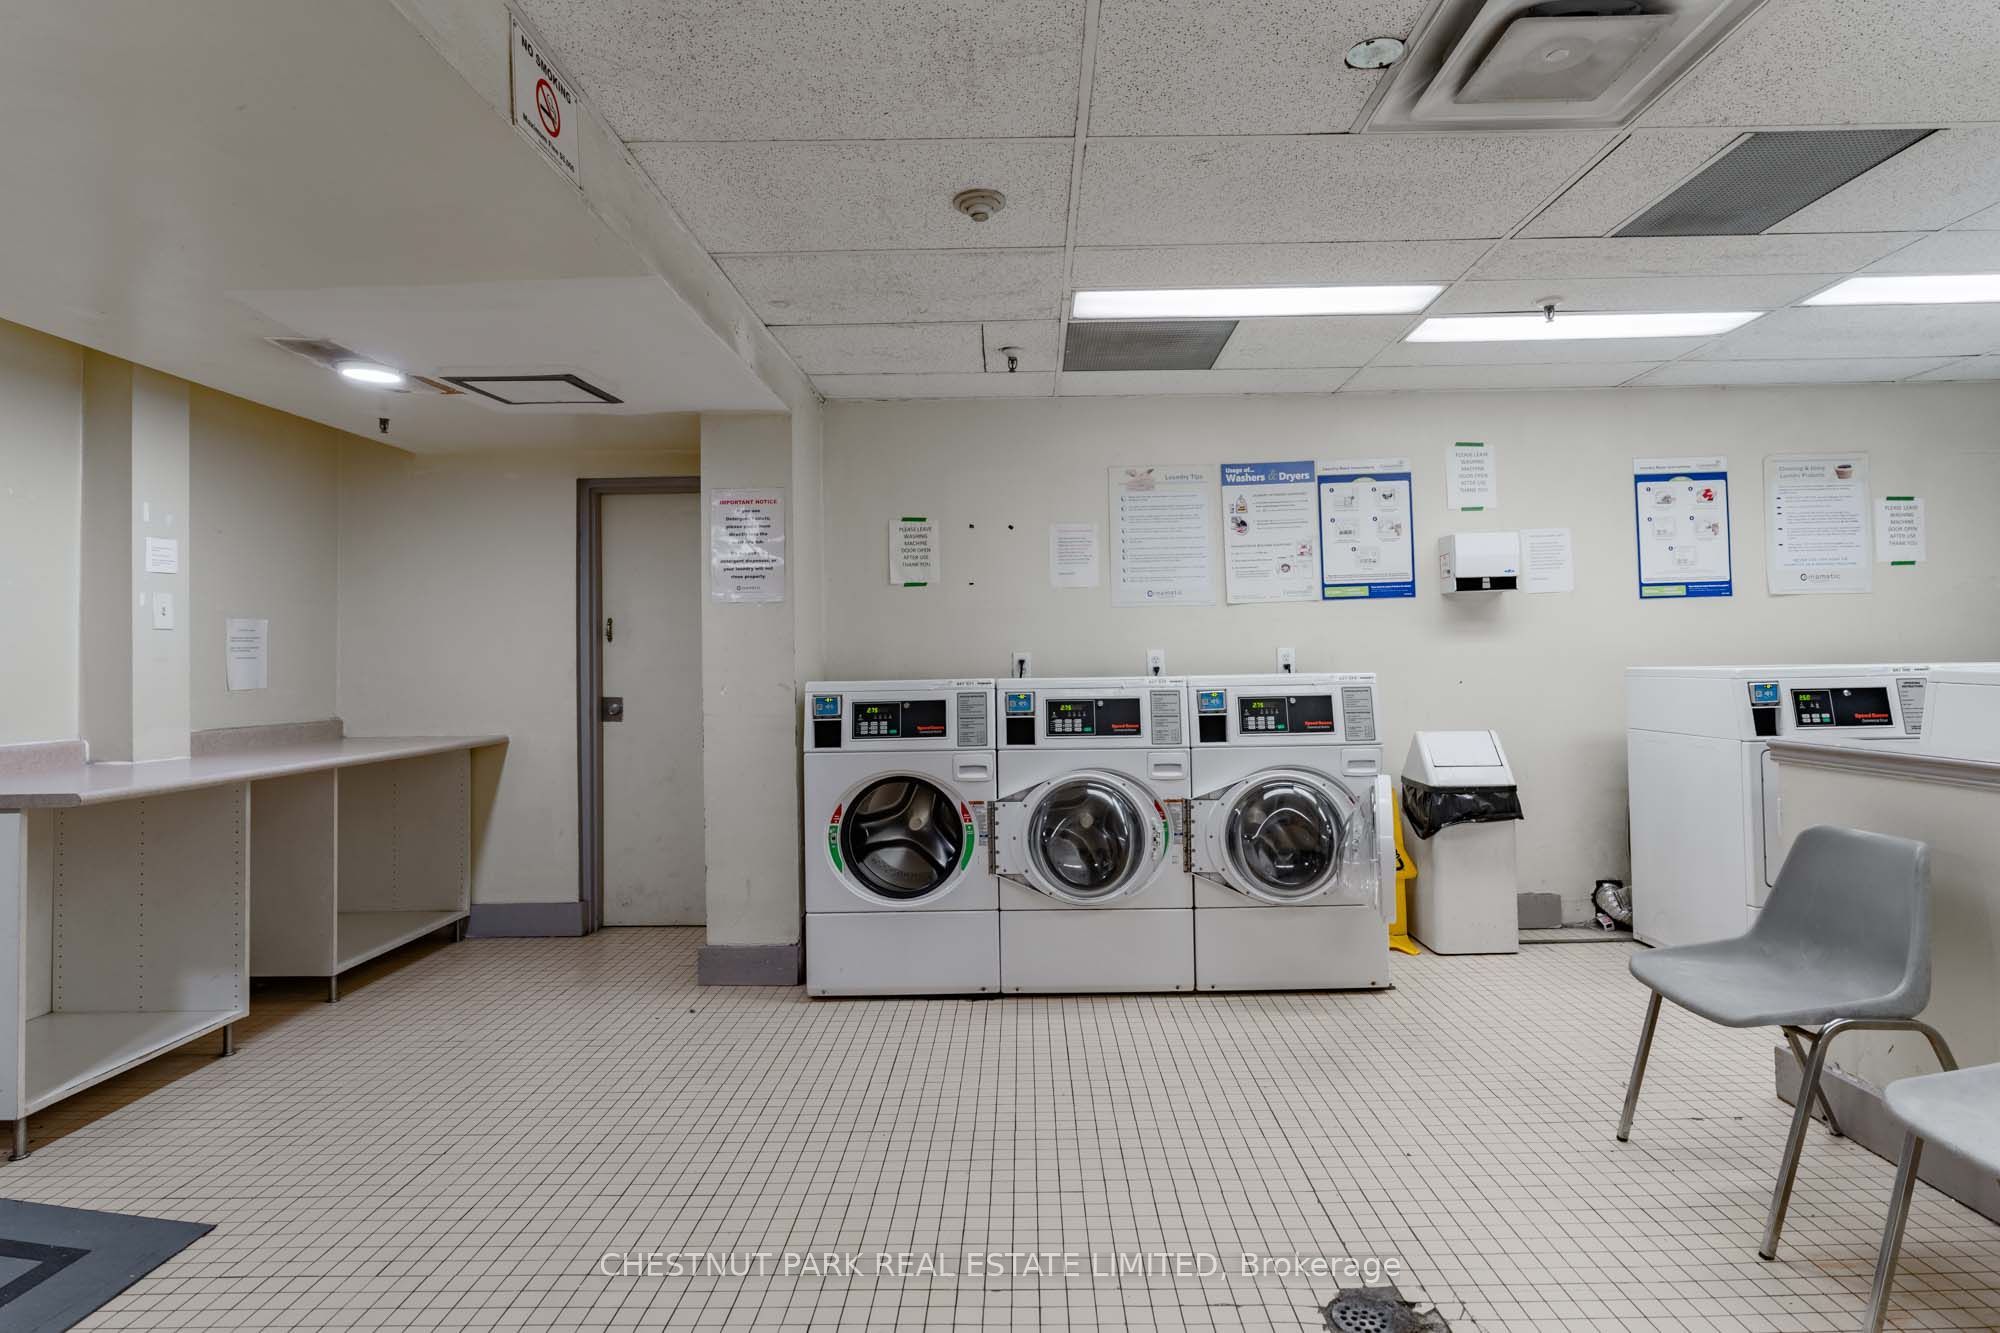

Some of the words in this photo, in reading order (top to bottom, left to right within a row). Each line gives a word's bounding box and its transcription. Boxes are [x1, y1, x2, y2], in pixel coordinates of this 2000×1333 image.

[521, 35, 533, 57] NO
[535, 54, 572, 104] SMOKING
[522, 112, 548, 144] Maximum
[1226, 473, 1265, 483] Washers
[1279, 472, 1310, 482] Dryers
